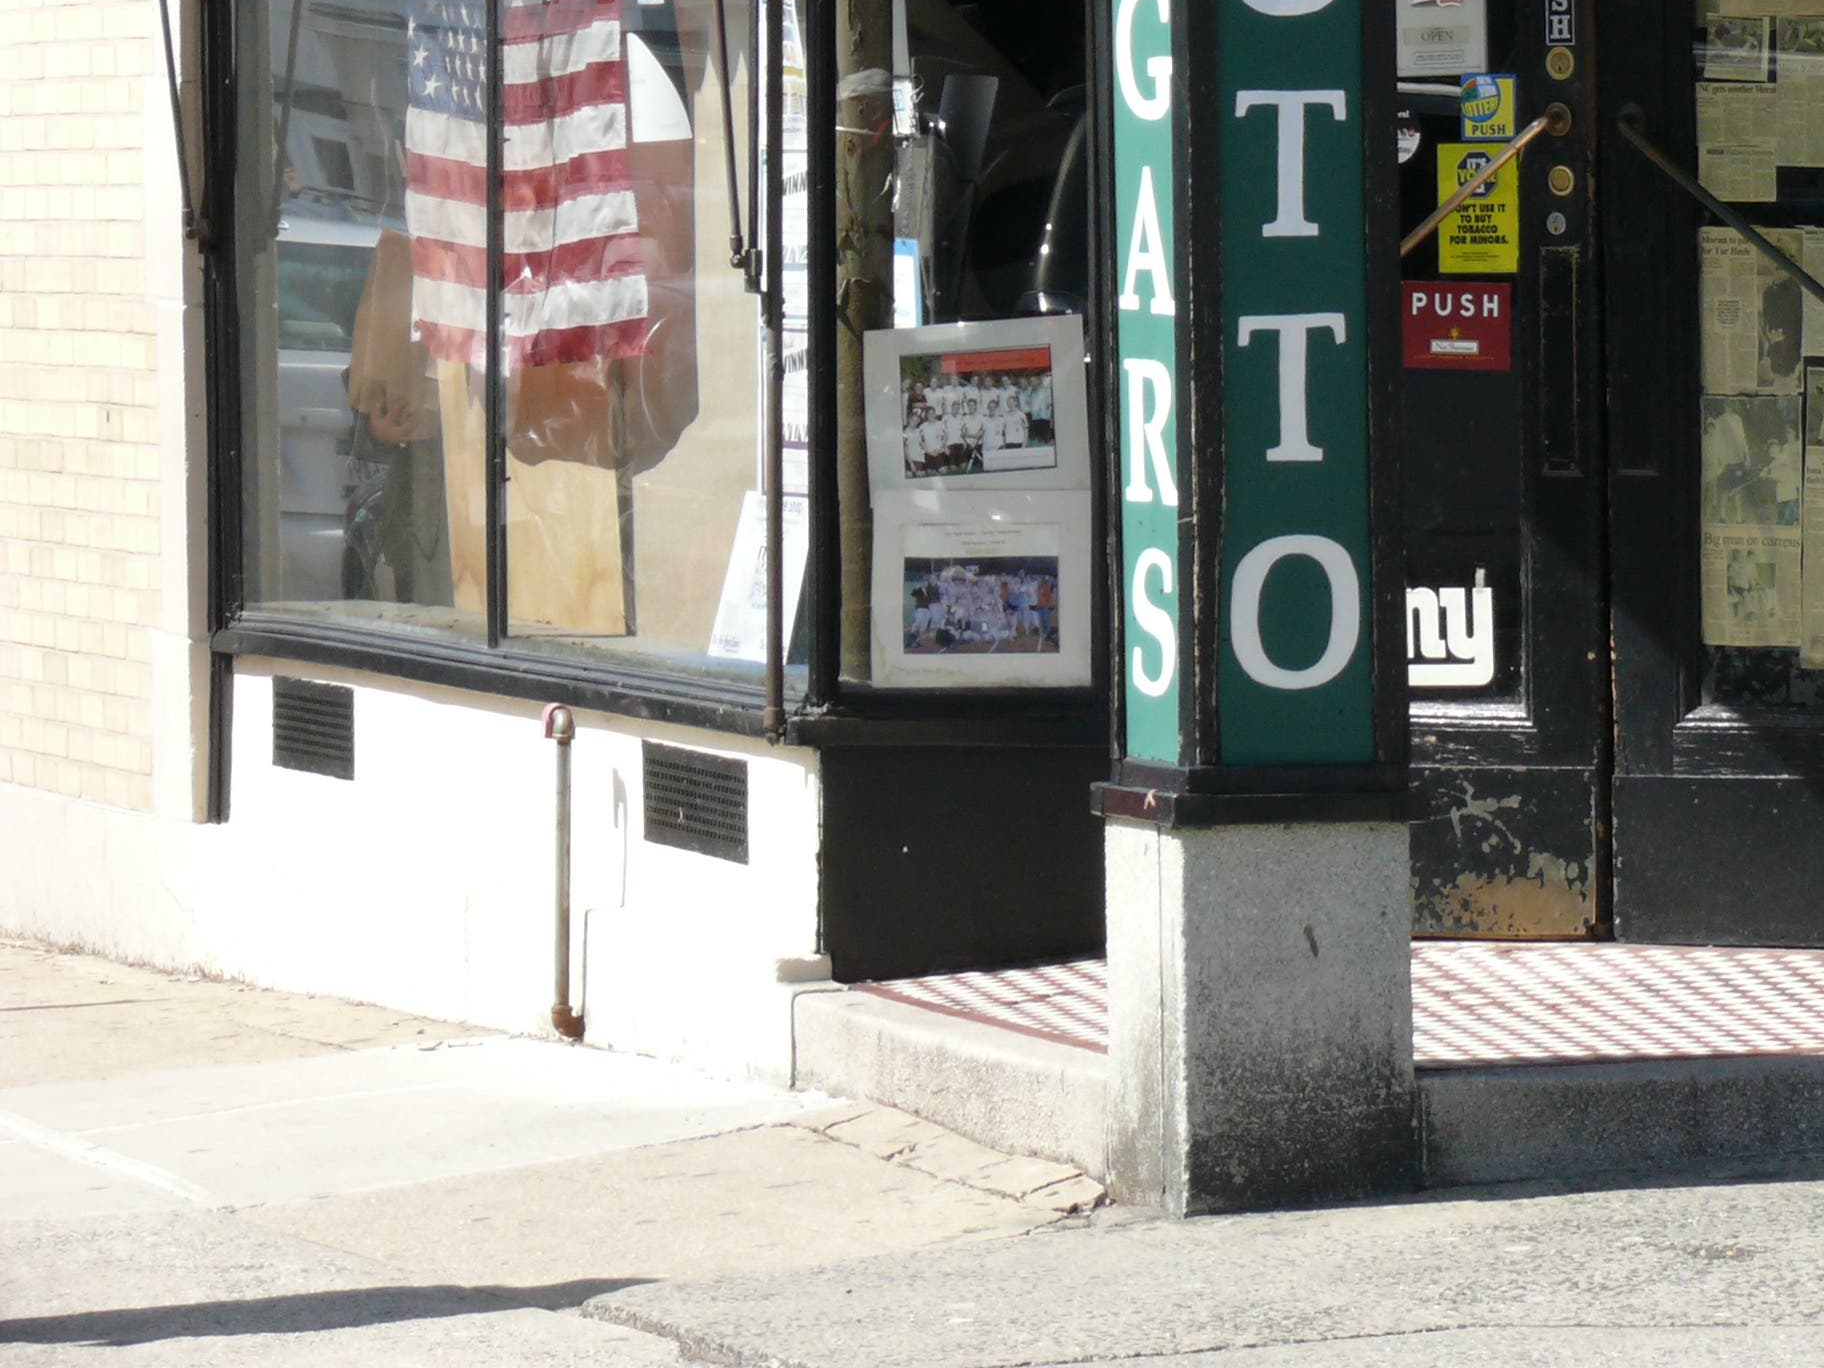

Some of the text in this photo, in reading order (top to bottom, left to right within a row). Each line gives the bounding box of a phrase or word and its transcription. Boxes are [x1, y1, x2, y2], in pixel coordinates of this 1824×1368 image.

[1420, 30, 1454, 41] OPEN
[1472, 124, 1506, 136] PUSH
[1455, 204, 1477, 213] ON'T
[1460, 215, 1493, 223] TO BUY
[1457, 225, 1498, 234] TOBACCO
[1449, 235, 1467, 244] FOR
[1411, 292, 1500, 318] PUSH
